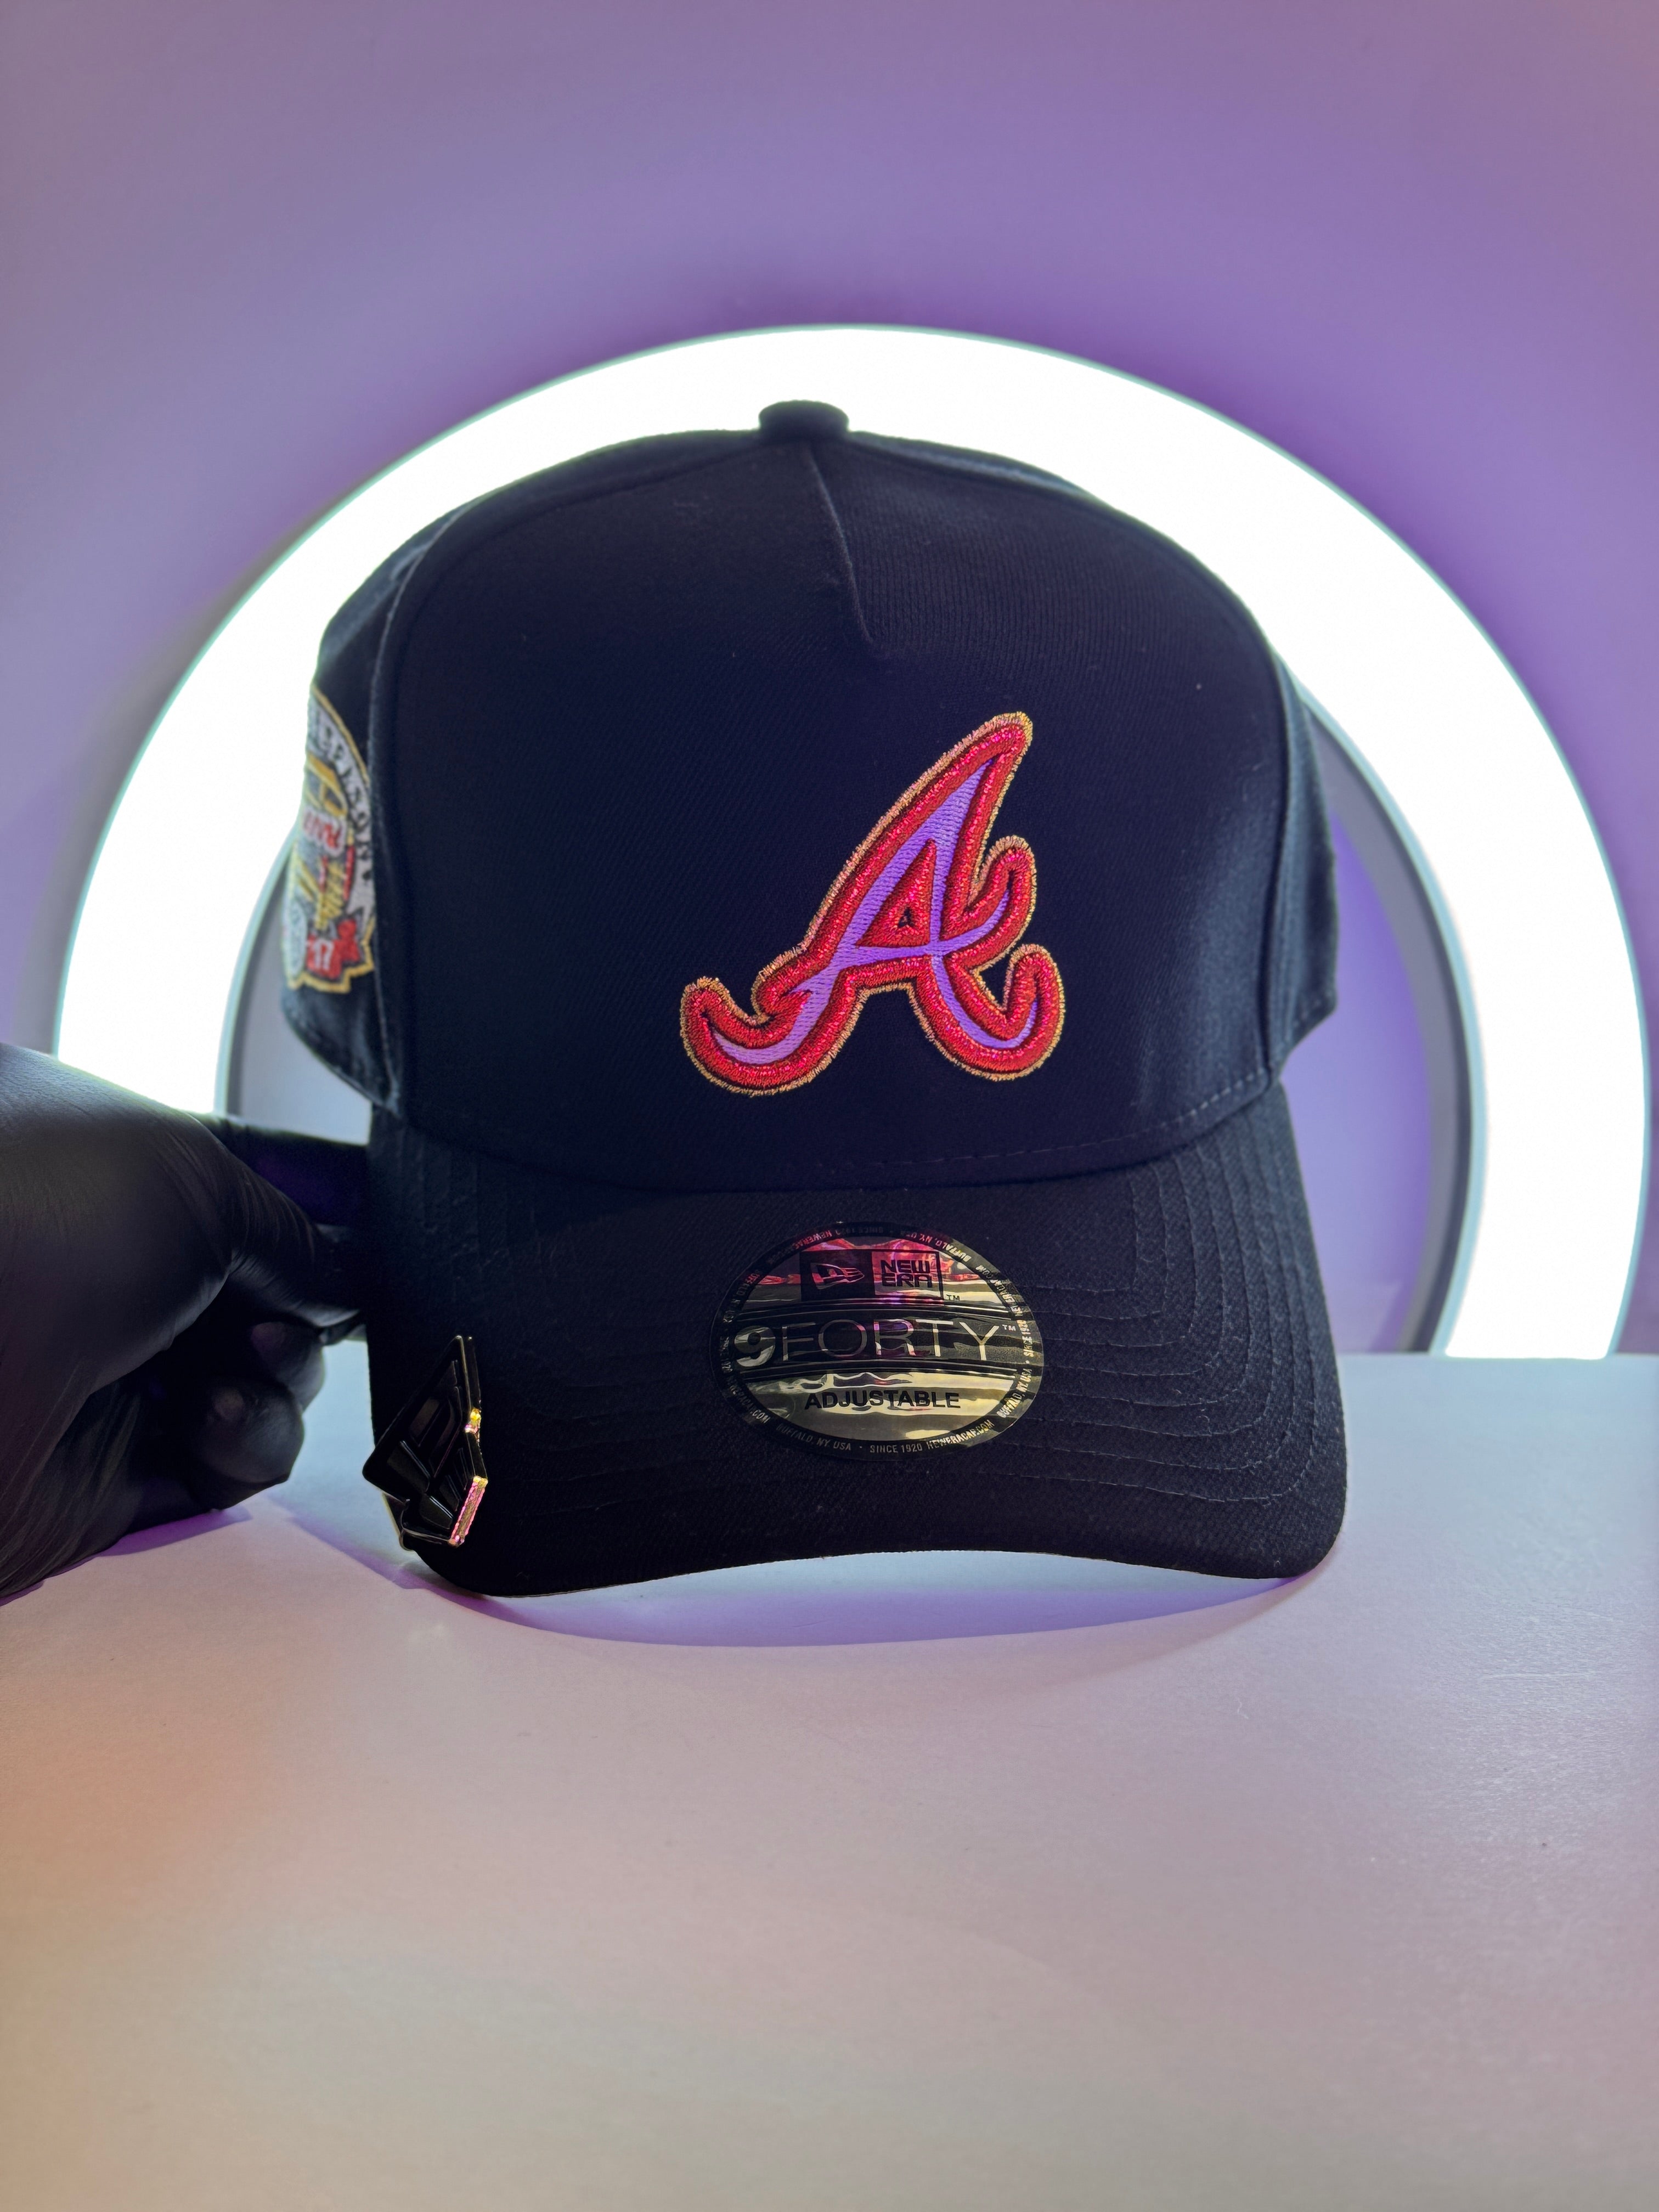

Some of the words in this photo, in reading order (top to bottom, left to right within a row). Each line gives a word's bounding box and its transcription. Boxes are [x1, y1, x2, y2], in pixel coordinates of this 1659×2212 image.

[680, 711, 1064, 1097] A
[881, 1260, 930, 1273] NEW
[882, 1273, 932, 1288] ERA
[734, 1319, 1000, 1368] 9FORTY
[804, 1390, 961, 1410] ADJUSTABLE
[833, 1442, 852, 1451] USA
[870, 1444, 898, 1454] SINCE
[900, 1443, 923, 1454] 1920
